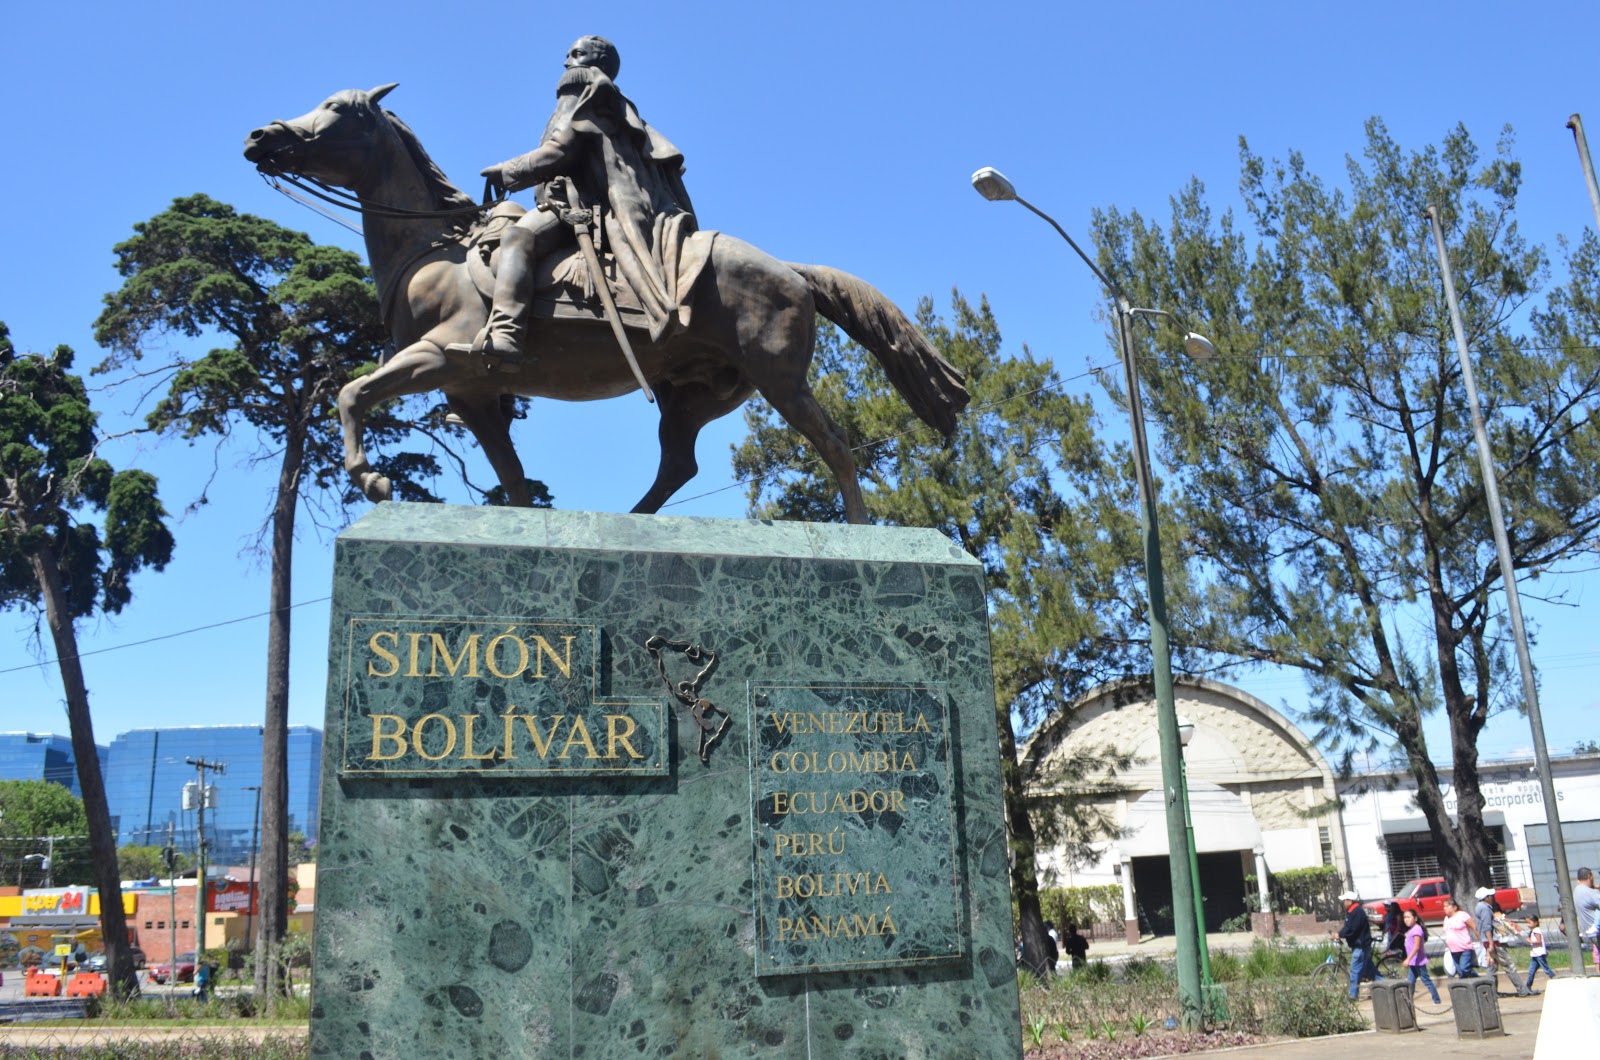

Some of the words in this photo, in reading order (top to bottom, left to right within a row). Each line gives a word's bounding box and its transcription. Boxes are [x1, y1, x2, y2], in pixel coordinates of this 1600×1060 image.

[368, 626, 576, 679] SIMÓN
[366, 705, 644, 760] BOLÍVAR
[770, 712, 931, 734] VENEZUELA
[771, 751, 918, 773] COLOMBIA
[773, 790, 908, 815] ECUADOR
[1488, 792, 1564, 808] corporatis
[774, 826, 846, 857] PERÚ
[776, 872, 893, 899] BOLIVIA
[61, 892, 81, 910] 24
[777, 906, 898, 941] PANAMÁ
